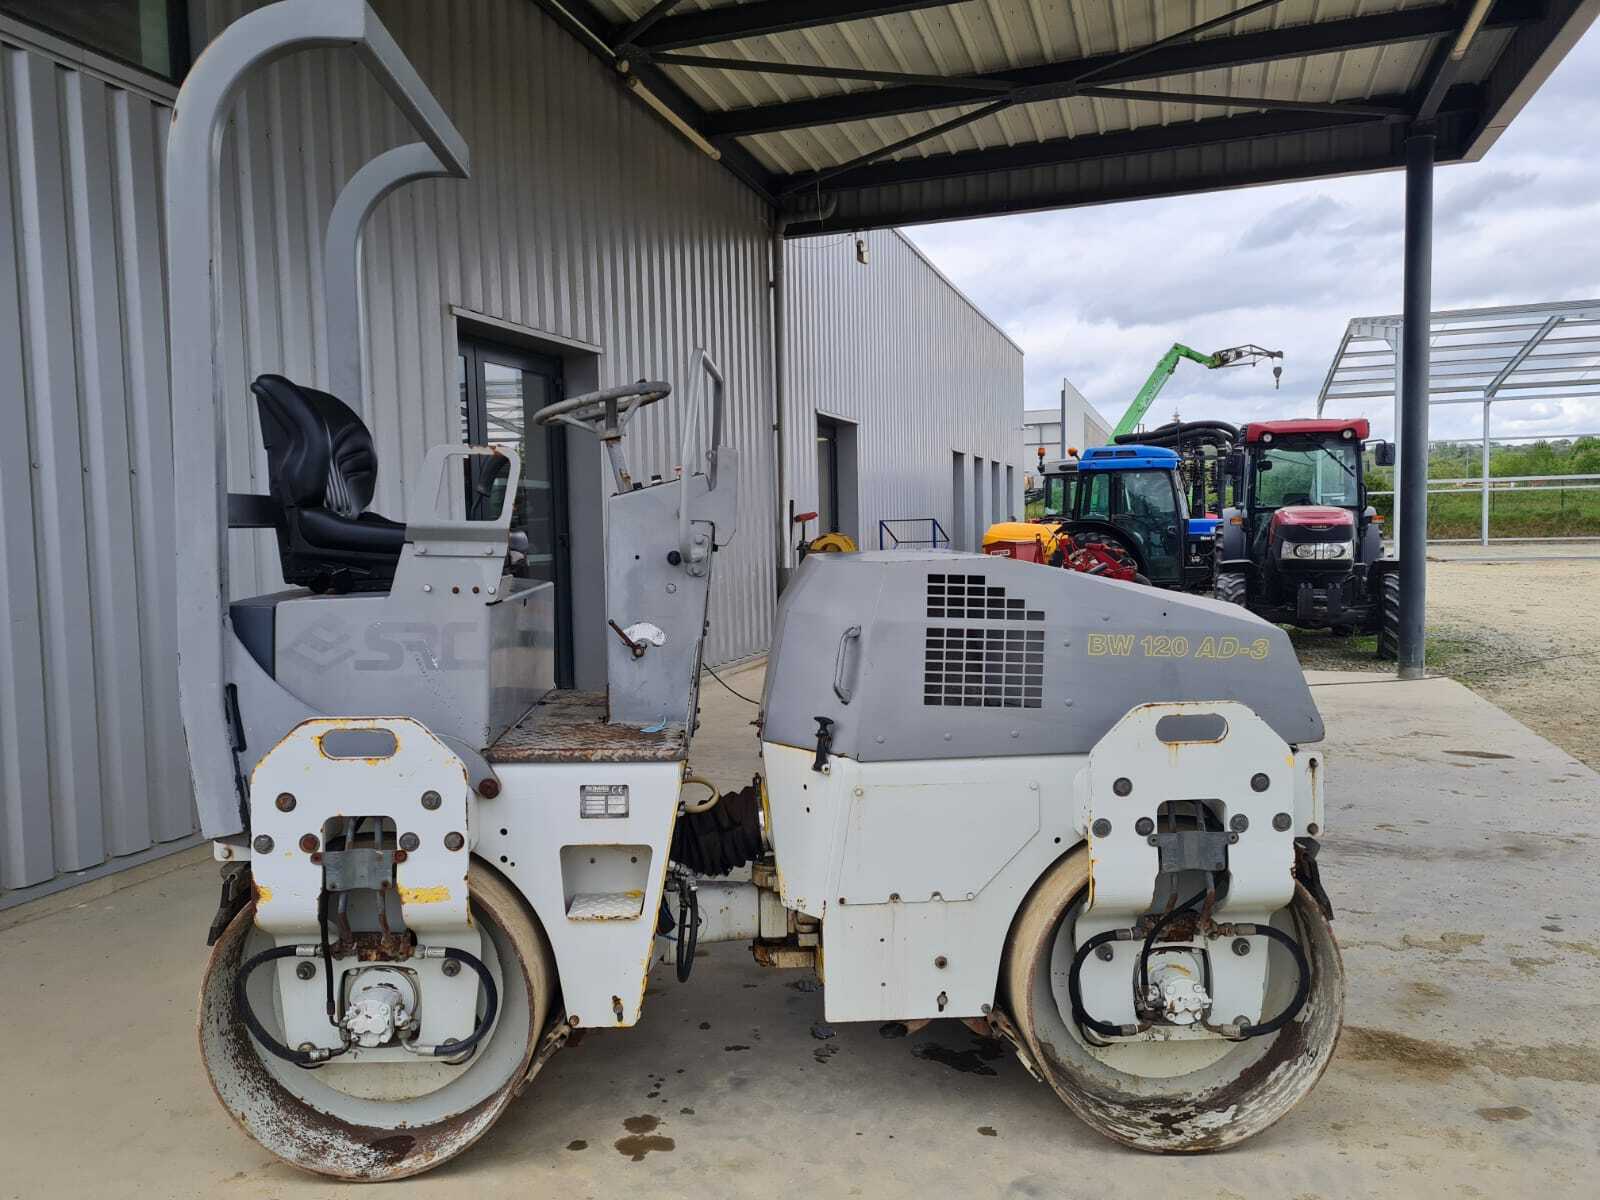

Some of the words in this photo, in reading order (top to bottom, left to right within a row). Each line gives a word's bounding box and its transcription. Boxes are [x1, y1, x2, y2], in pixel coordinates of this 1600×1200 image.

[1087, 633, 1136, 656] BW
[1141, 635, 1189, 657] 120
[1194, 636, 1271, 660] AD-3
